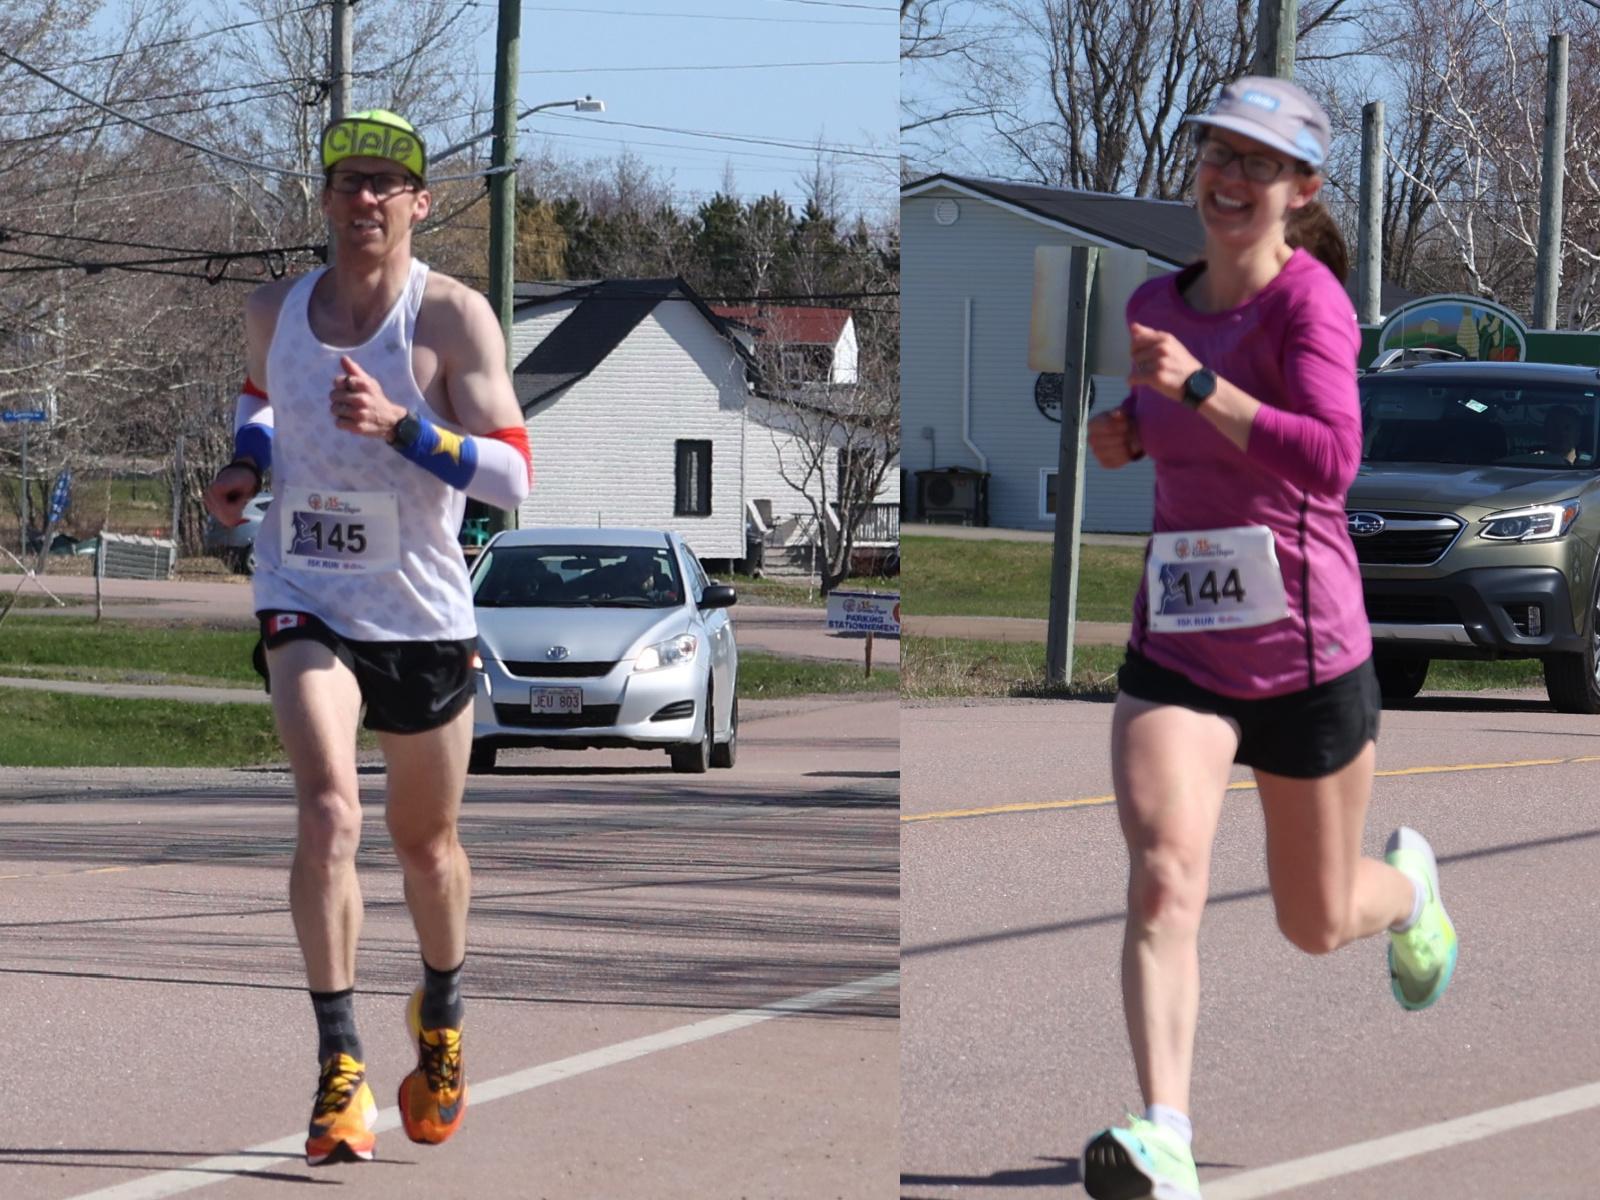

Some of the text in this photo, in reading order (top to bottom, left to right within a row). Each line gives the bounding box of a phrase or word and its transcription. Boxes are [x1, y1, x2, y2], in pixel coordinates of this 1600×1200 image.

[310, 521, 367, 554] 145
[1177, 568, 1246, 607] 144
[846, 613, 884, 624] PARKING
[1194, 616, 1215, 625] RUN
[828, 620, 900, 633] STATIONNEMENT
[533, 695, 579, 708] JEU 803
